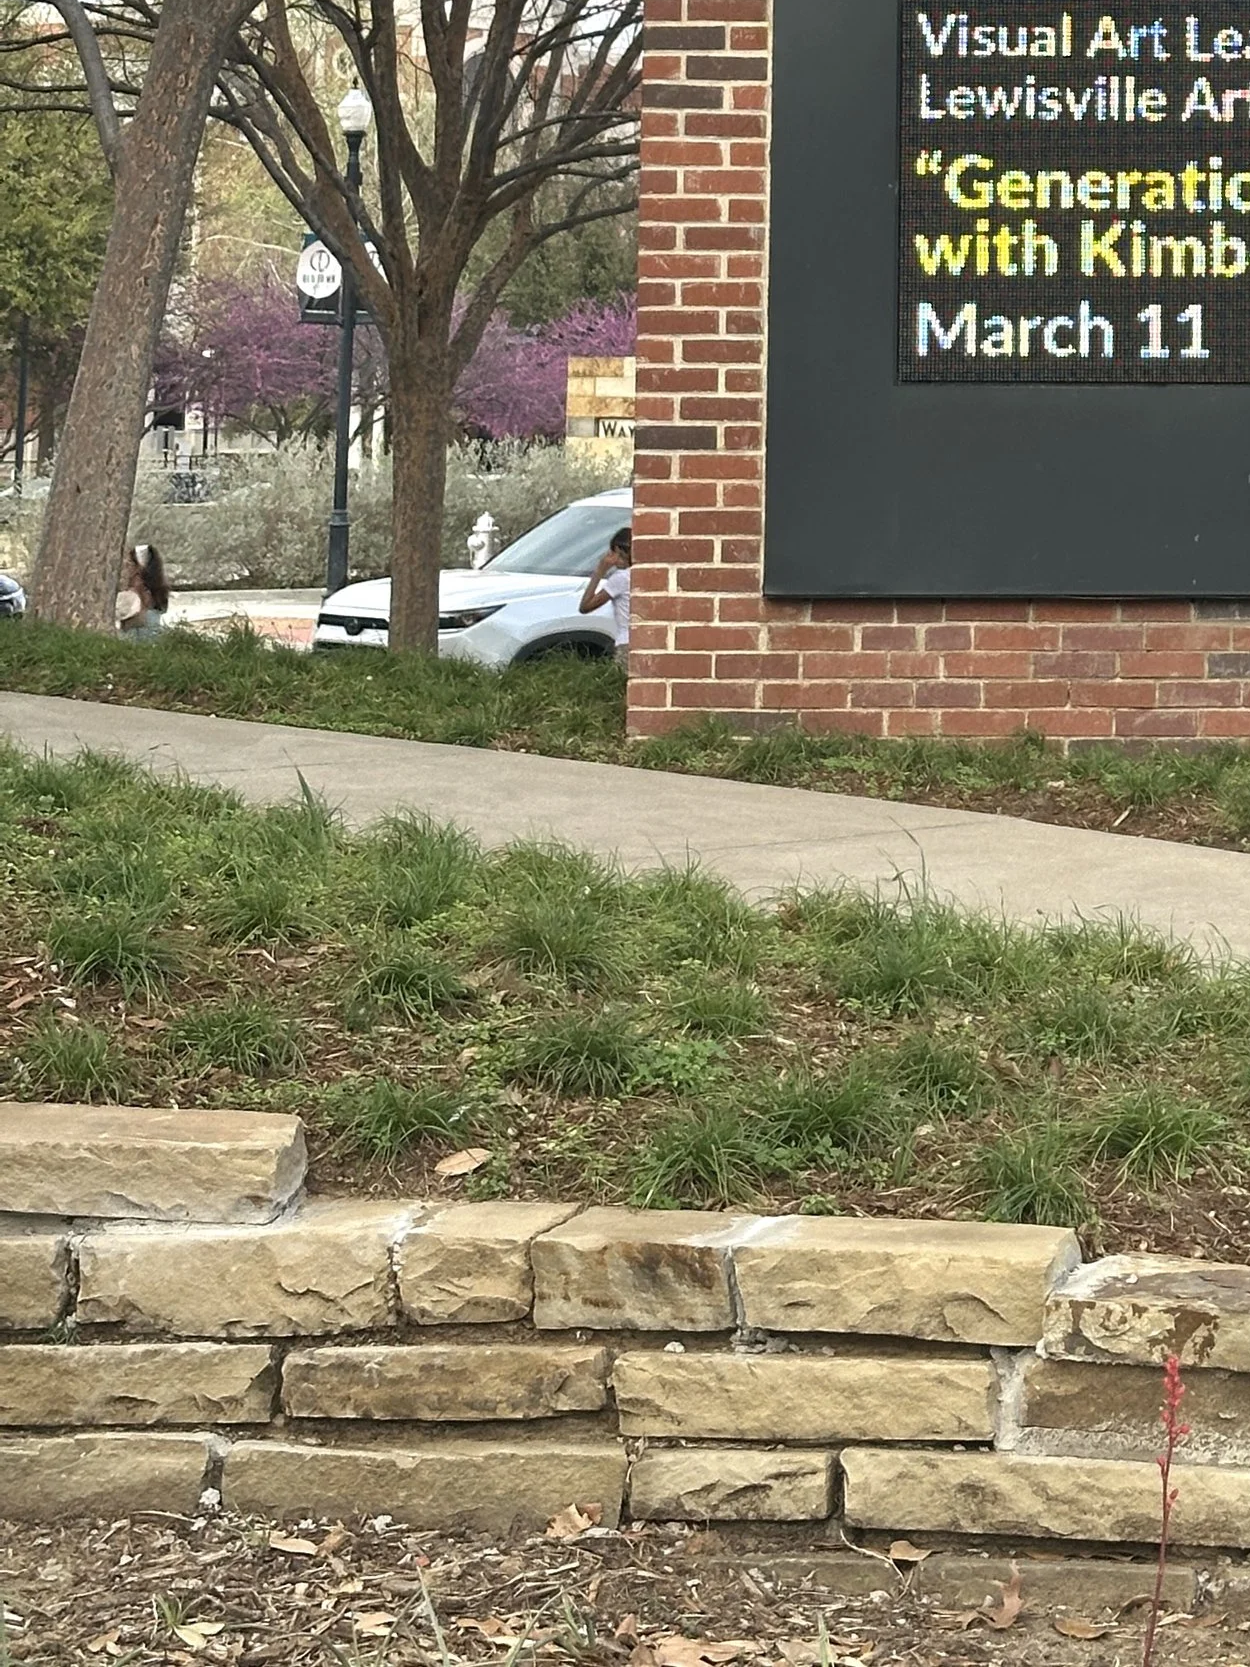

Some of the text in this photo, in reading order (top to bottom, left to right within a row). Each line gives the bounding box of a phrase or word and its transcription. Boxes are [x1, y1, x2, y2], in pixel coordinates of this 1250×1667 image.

[917, 11, 1072, 60] Visual
[1086, 14, 1171, 62] Art
[918, 74, 1168, 123] Lewisville
[913, 219, 1059, 278] with
[915, 300, 1210, 360] March 11
